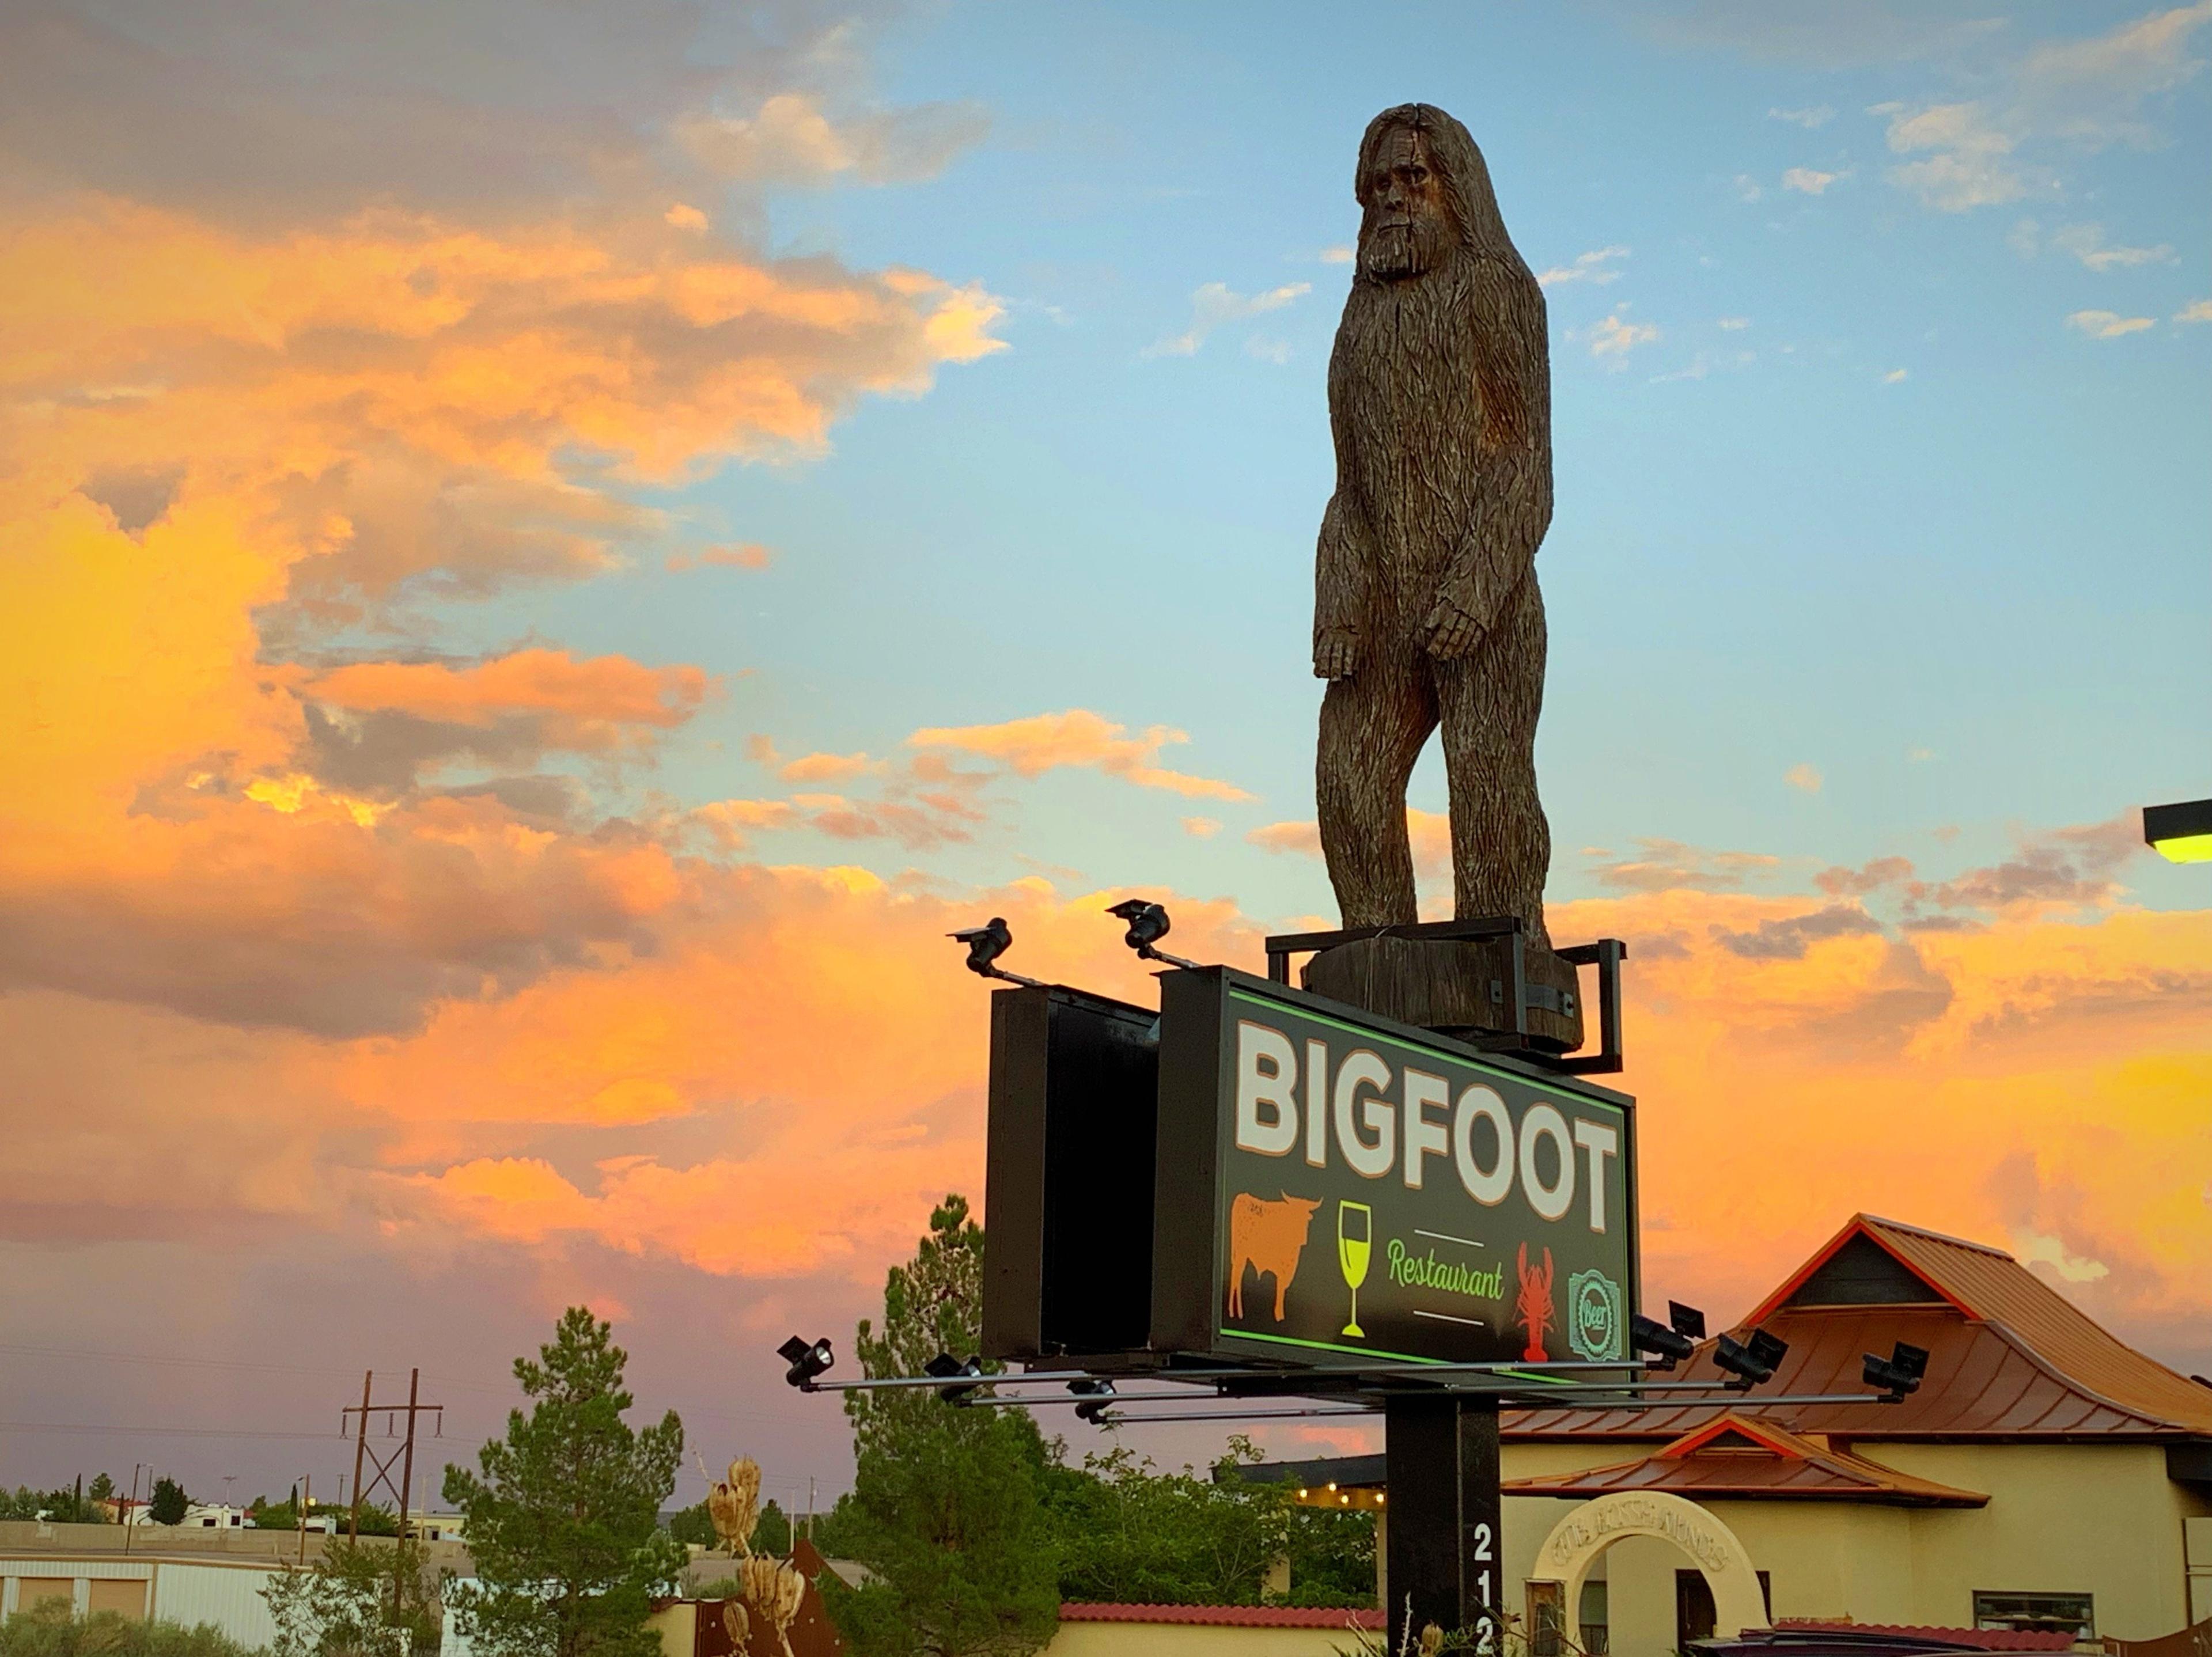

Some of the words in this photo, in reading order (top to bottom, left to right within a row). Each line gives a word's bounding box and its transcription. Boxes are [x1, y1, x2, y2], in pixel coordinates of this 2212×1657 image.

[1236, 1018, 1618, 1234] BIGFOOT
[1387, 1238, 1505, 1300] Restaurant
[1582, 1299, 1607, 1330] Beer
